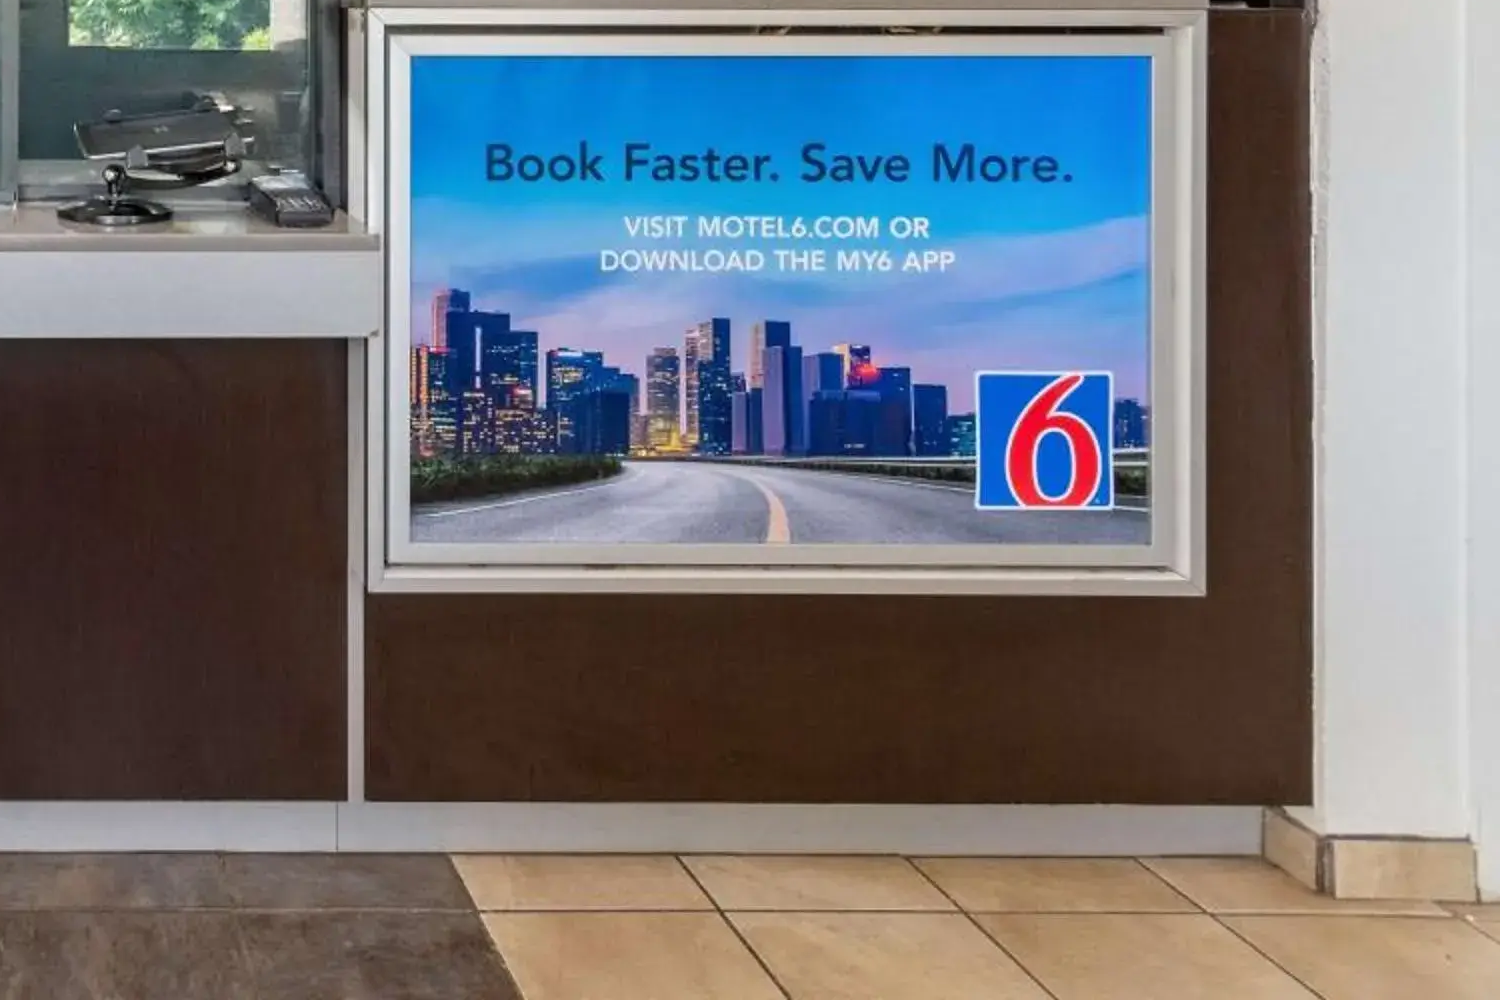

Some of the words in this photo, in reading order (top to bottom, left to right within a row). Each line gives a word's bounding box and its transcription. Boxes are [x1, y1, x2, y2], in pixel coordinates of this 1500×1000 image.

[484, 141, 603, 183] Book
[624, 142, 779, 183] Faster.
[800, 142, 910, 184] Save
[931, 142, 1074, 184] More.
[623, 216, 687, 238] VISIT
[697, 216, 879, 238] MOTEL6.COM
[888, 216, 929, 238] OR
[600, 251, 765, 273] DOWNLOAD
[774, 251, 826, 273] THE
[836, 251, 892, 273] MY6
[902, 251, 955, 273] APP
[1005, 371, 1102, 509] 6
